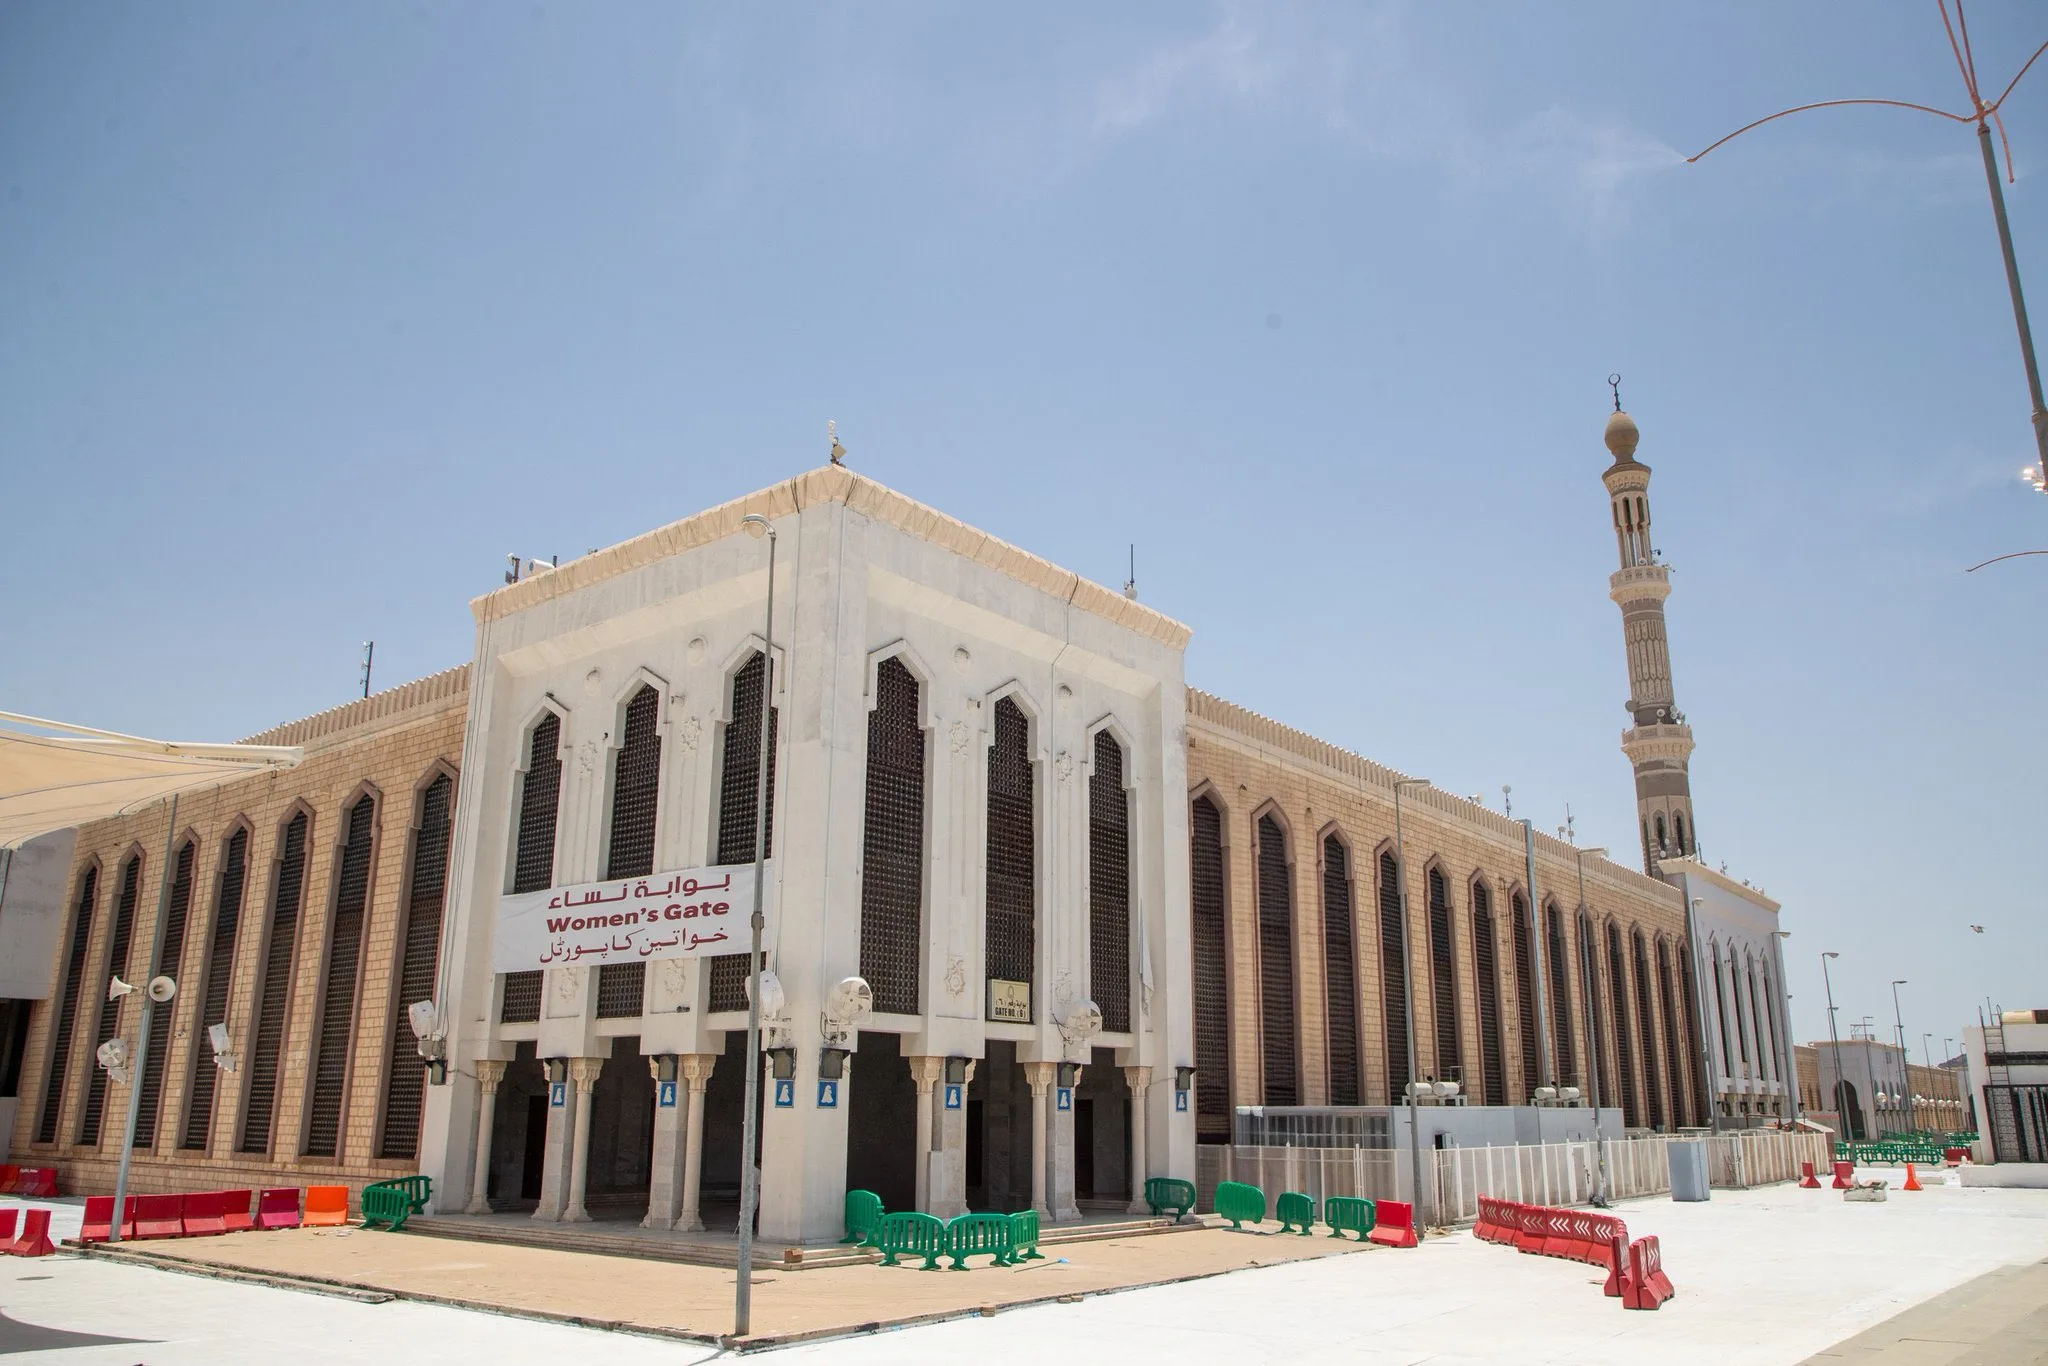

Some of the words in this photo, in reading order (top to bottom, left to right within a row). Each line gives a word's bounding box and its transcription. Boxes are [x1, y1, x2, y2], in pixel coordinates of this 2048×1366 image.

[548, 883, 628, 909] نساء
[633, 873, 731, 899] بوابة
[546, 907, 659, 933] Women's
[663, 901, 730, 921] Gate
[995, 1007, 1007, 1016] GATE
